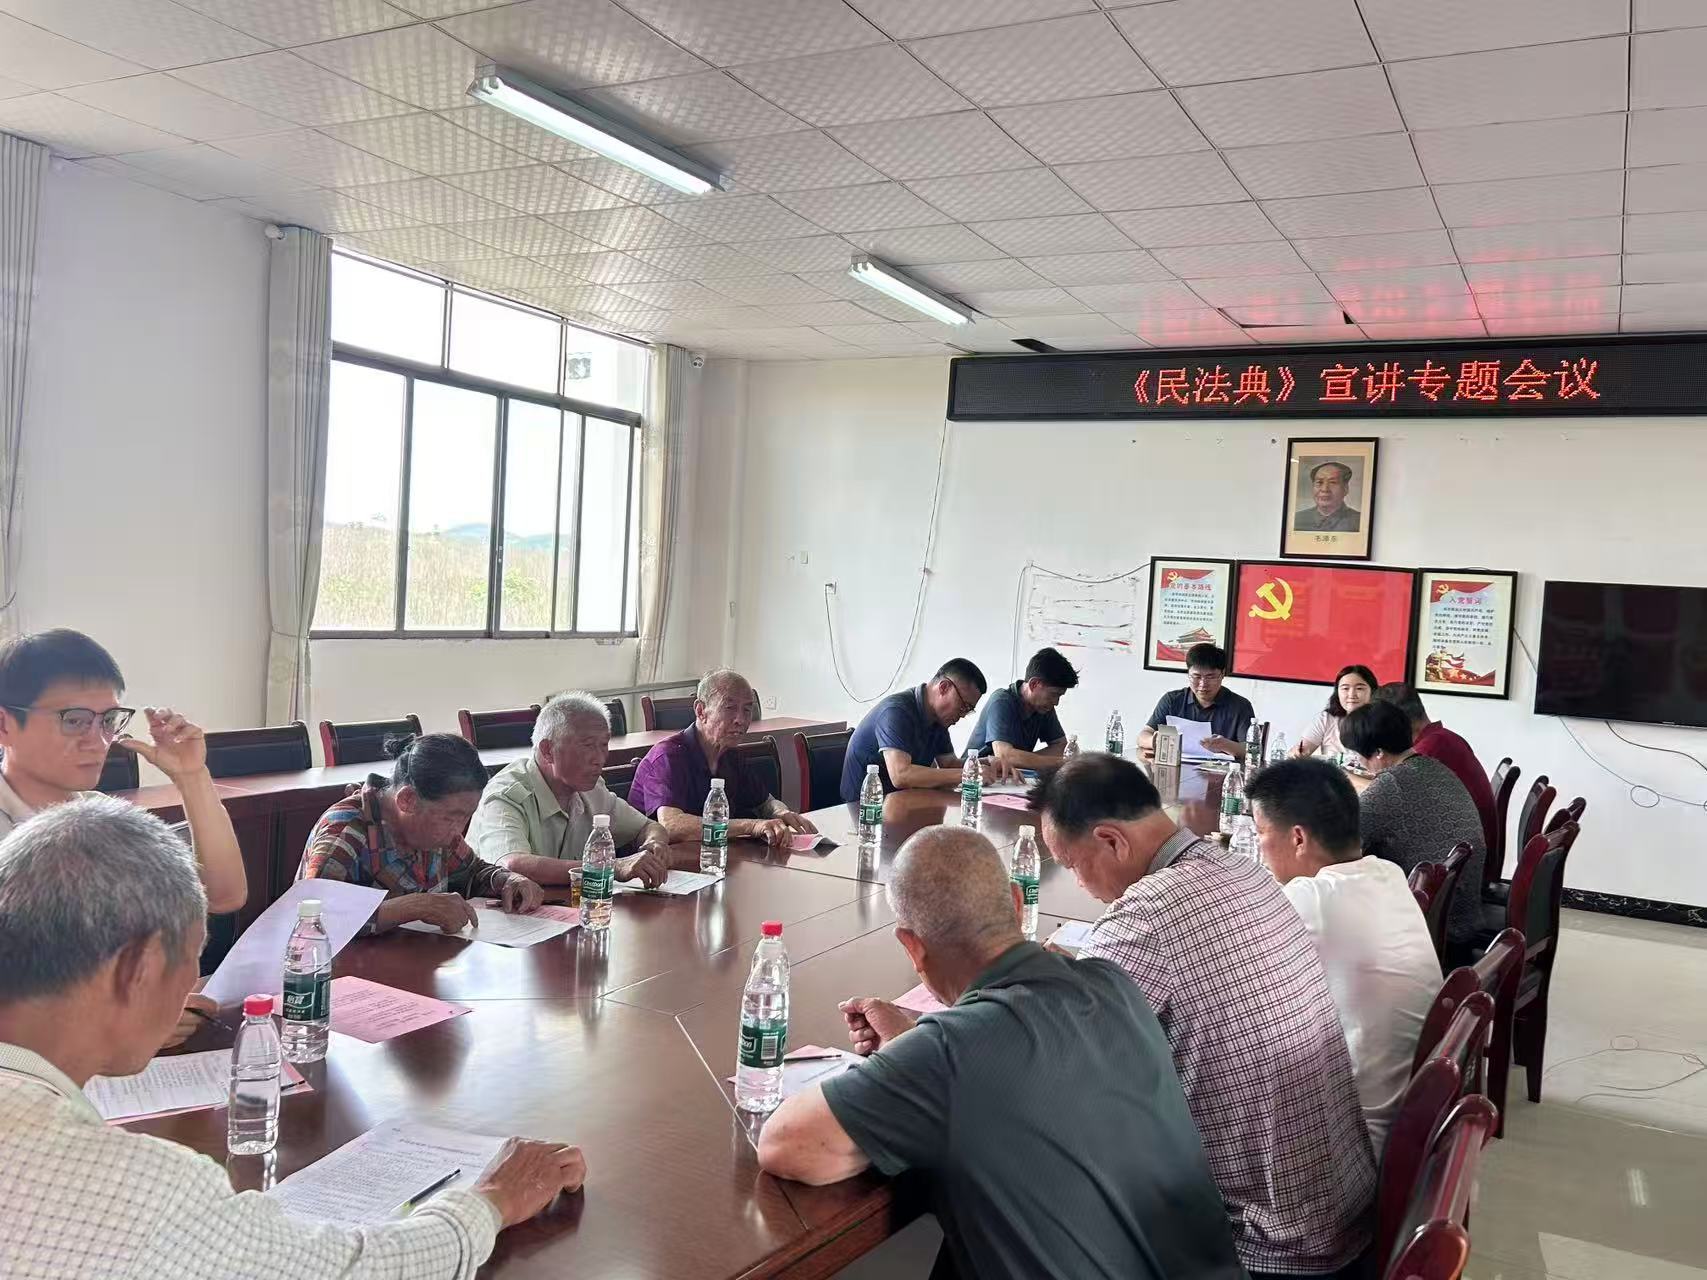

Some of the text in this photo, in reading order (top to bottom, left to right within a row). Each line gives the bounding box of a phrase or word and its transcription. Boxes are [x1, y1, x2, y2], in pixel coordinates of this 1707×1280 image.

[1134, 357, 1600, 405] 《民法典》宣讲专题会议
